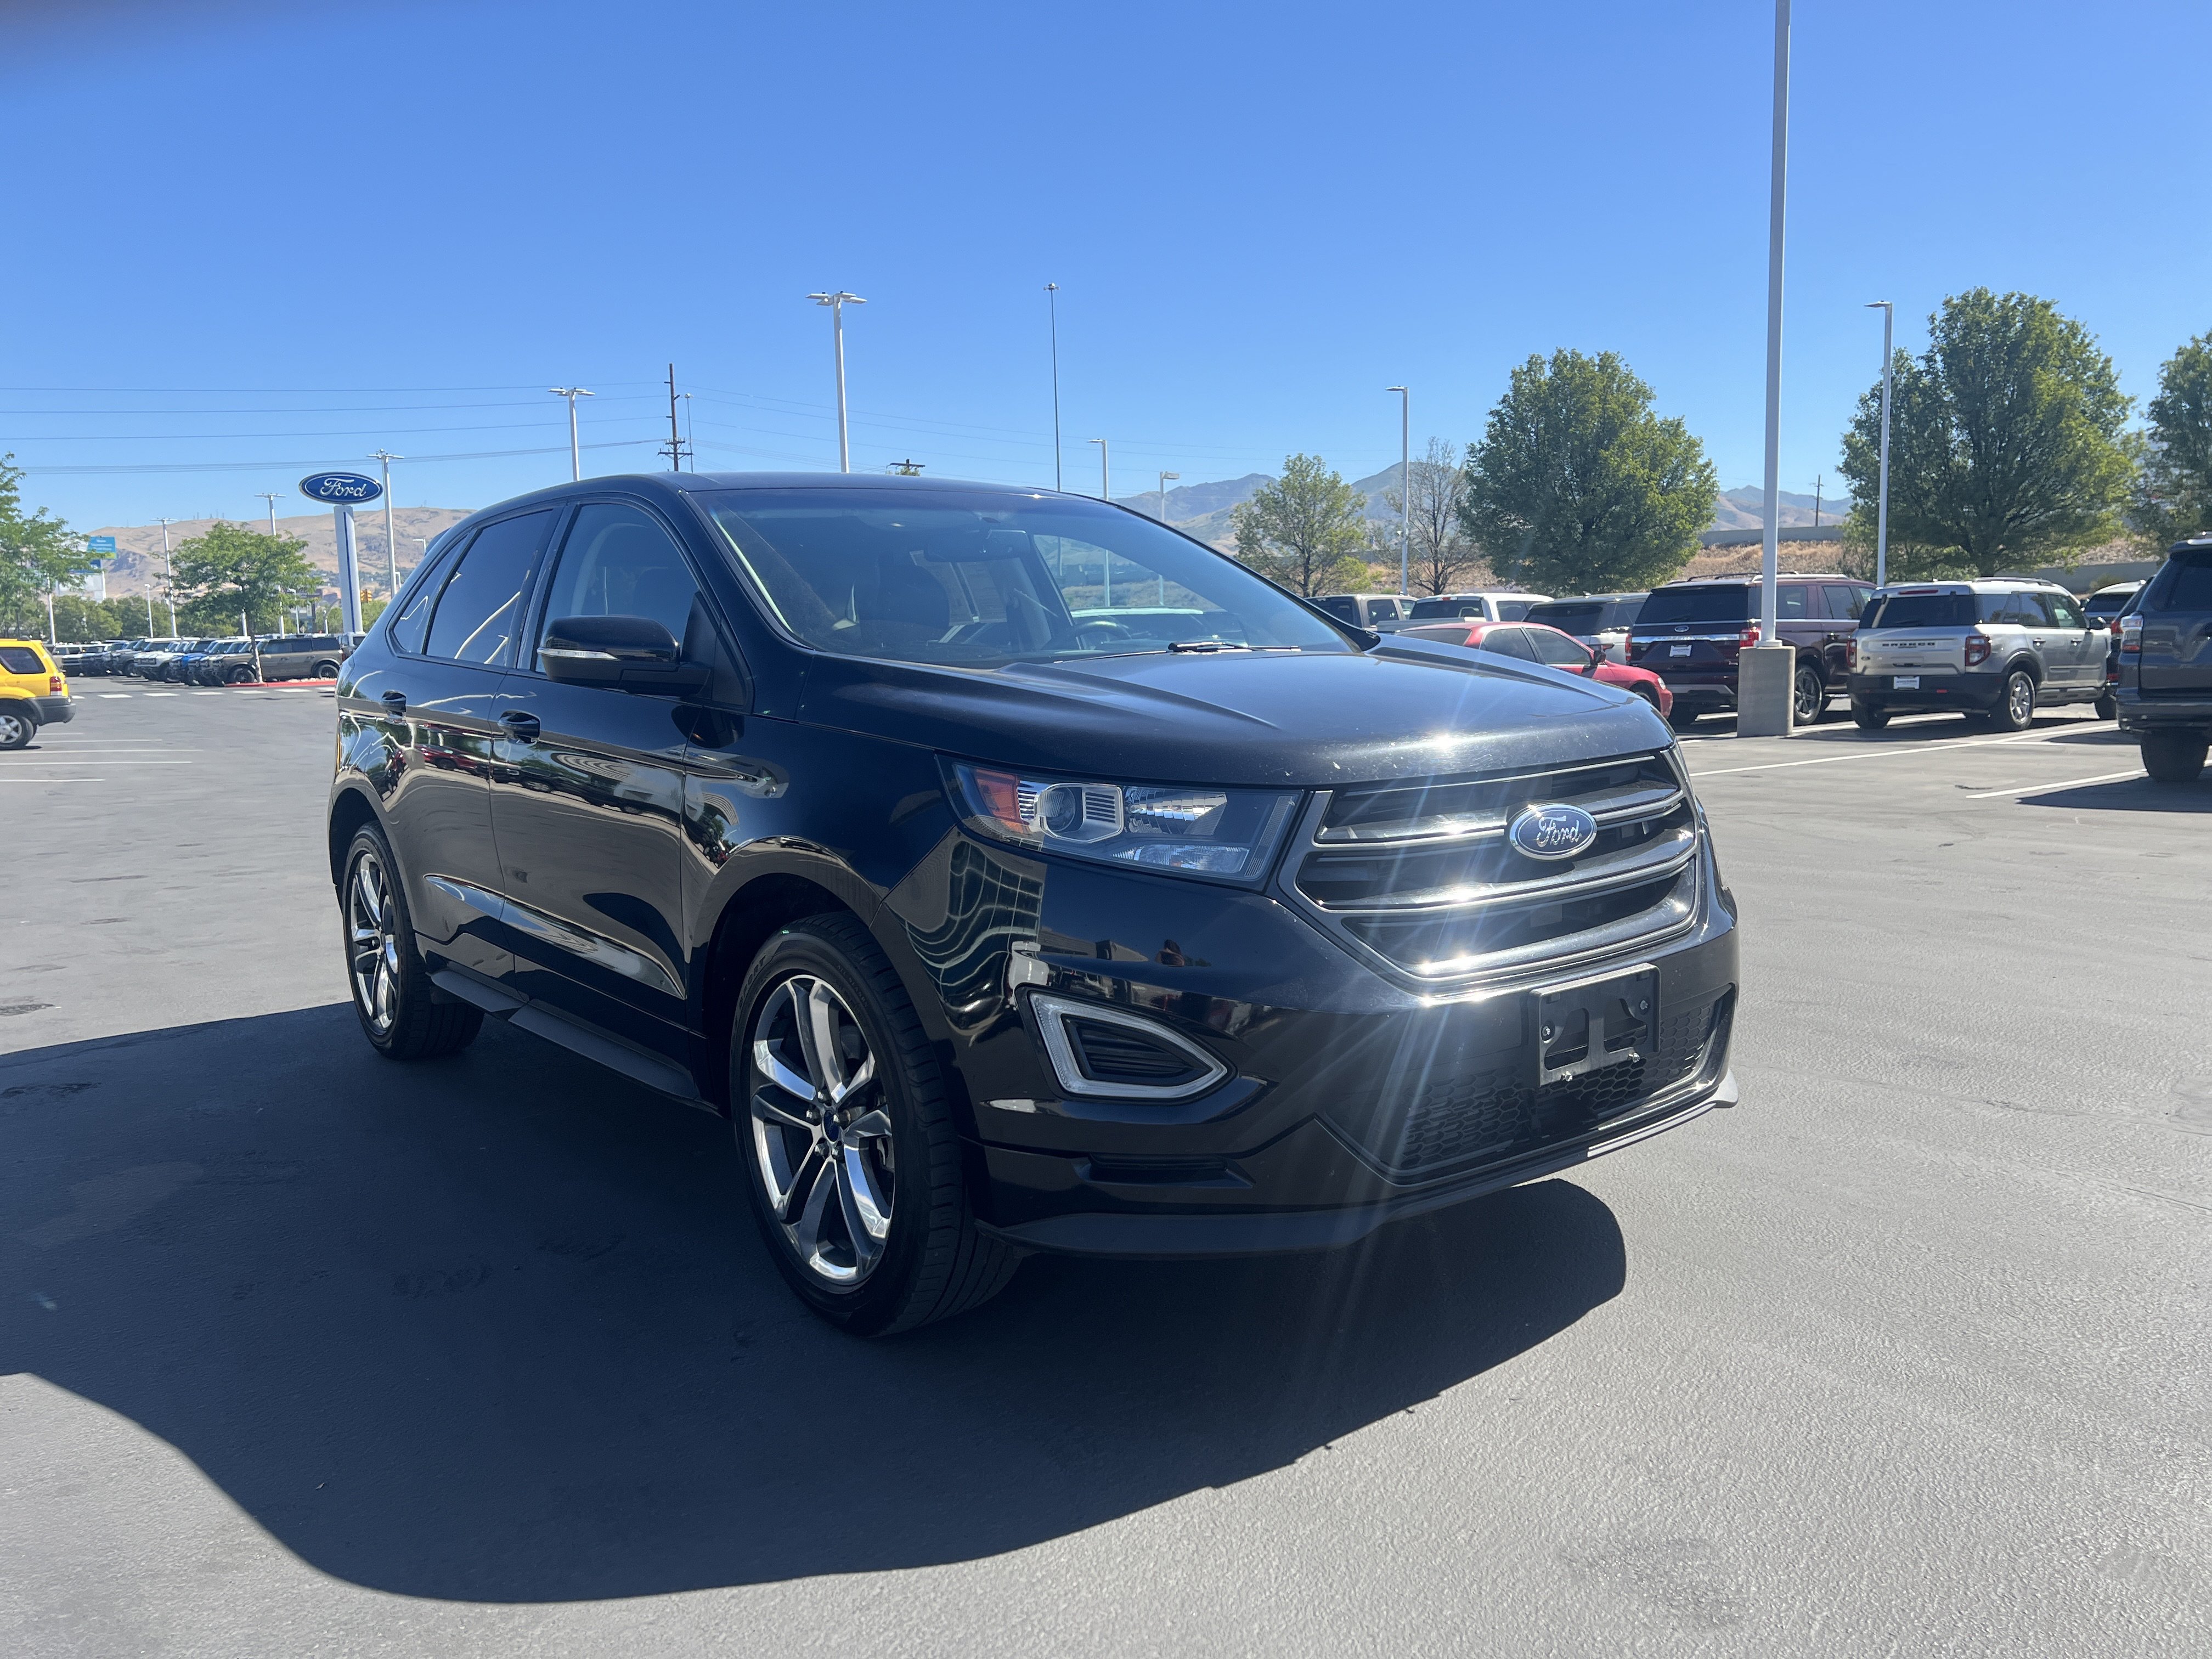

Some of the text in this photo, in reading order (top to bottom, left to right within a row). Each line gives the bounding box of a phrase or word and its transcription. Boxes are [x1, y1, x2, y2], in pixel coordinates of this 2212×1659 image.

[319, 477, 367, 496] Ford
[1536, 815, 1583, 848] Ford
[739, 953, 766, 1010] SPORT
